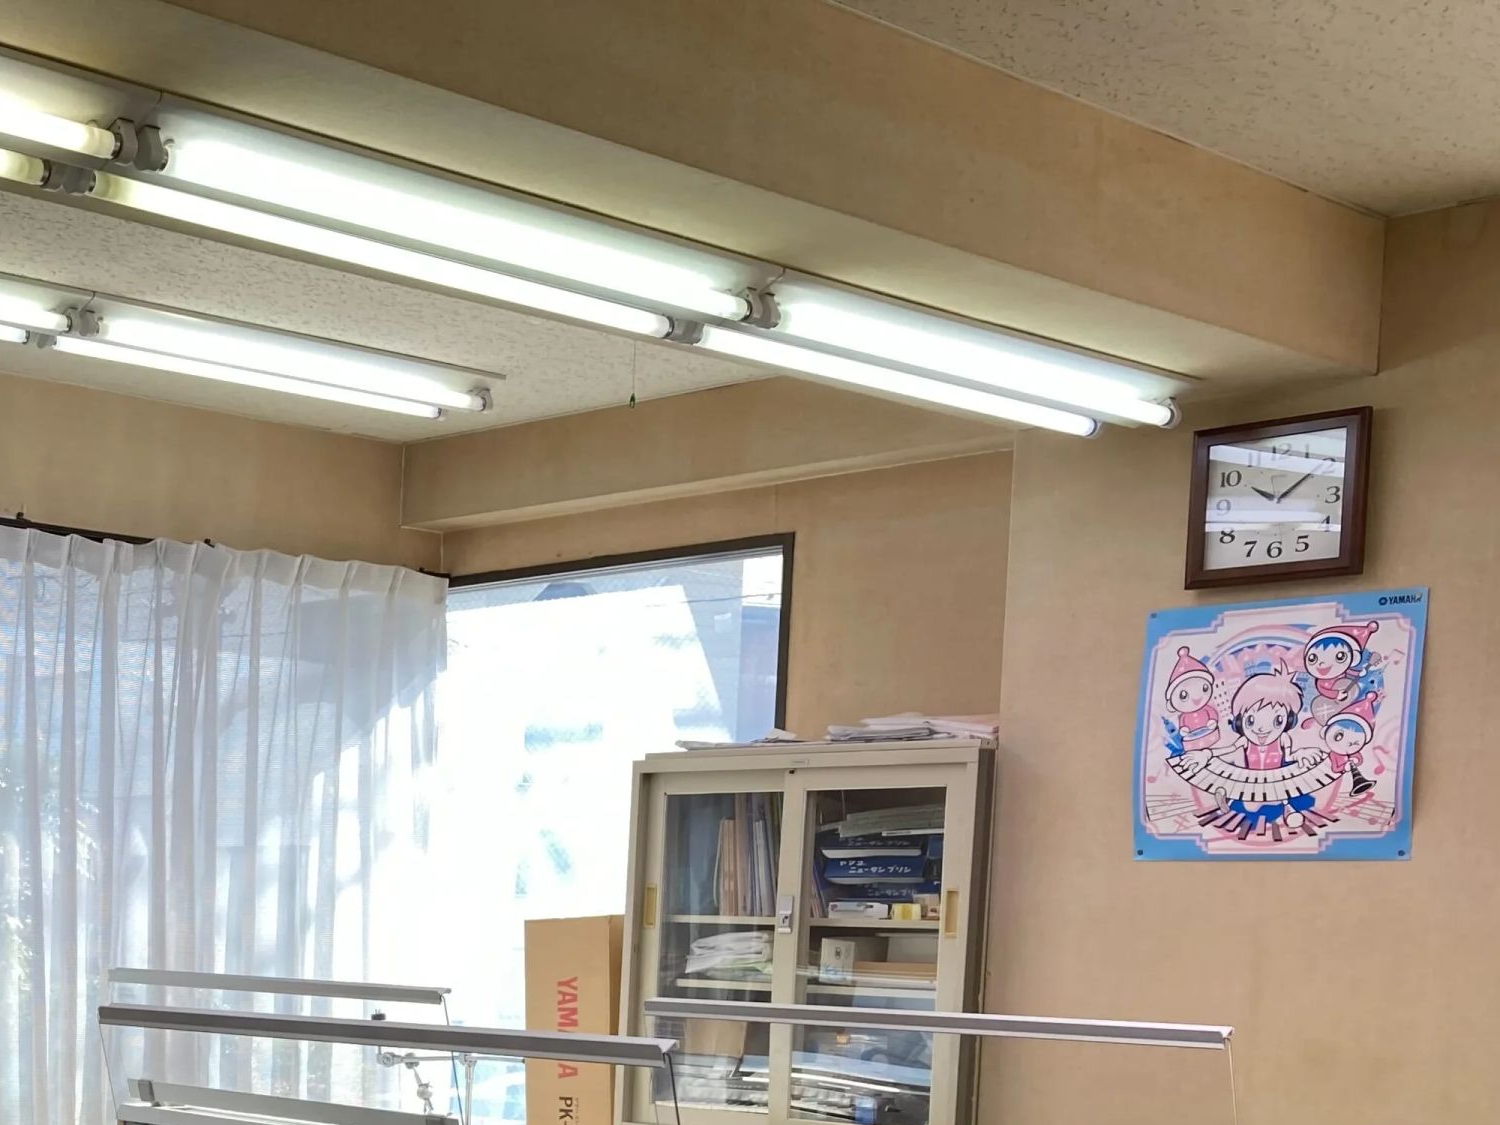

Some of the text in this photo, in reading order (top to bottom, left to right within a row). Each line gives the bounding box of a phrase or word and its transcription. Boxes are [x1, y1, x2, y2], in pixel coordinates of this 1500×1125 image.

[1271, 443, 1292, 461] 12
[1219, 470, 1242, 488] 10
[1325, 486, 1341, 503] 3
[1216, 499, 1231, 516] 9
[1318, 515, 1332, 532] 4
[1219, 529, 1235, 544] 8
[1295, 535, 1310, 552] 5
[1243, 540, 1258, 557] 7
[1266, 541, 1283, 558] 6
[557, 976, 579, 1079] YAMA
